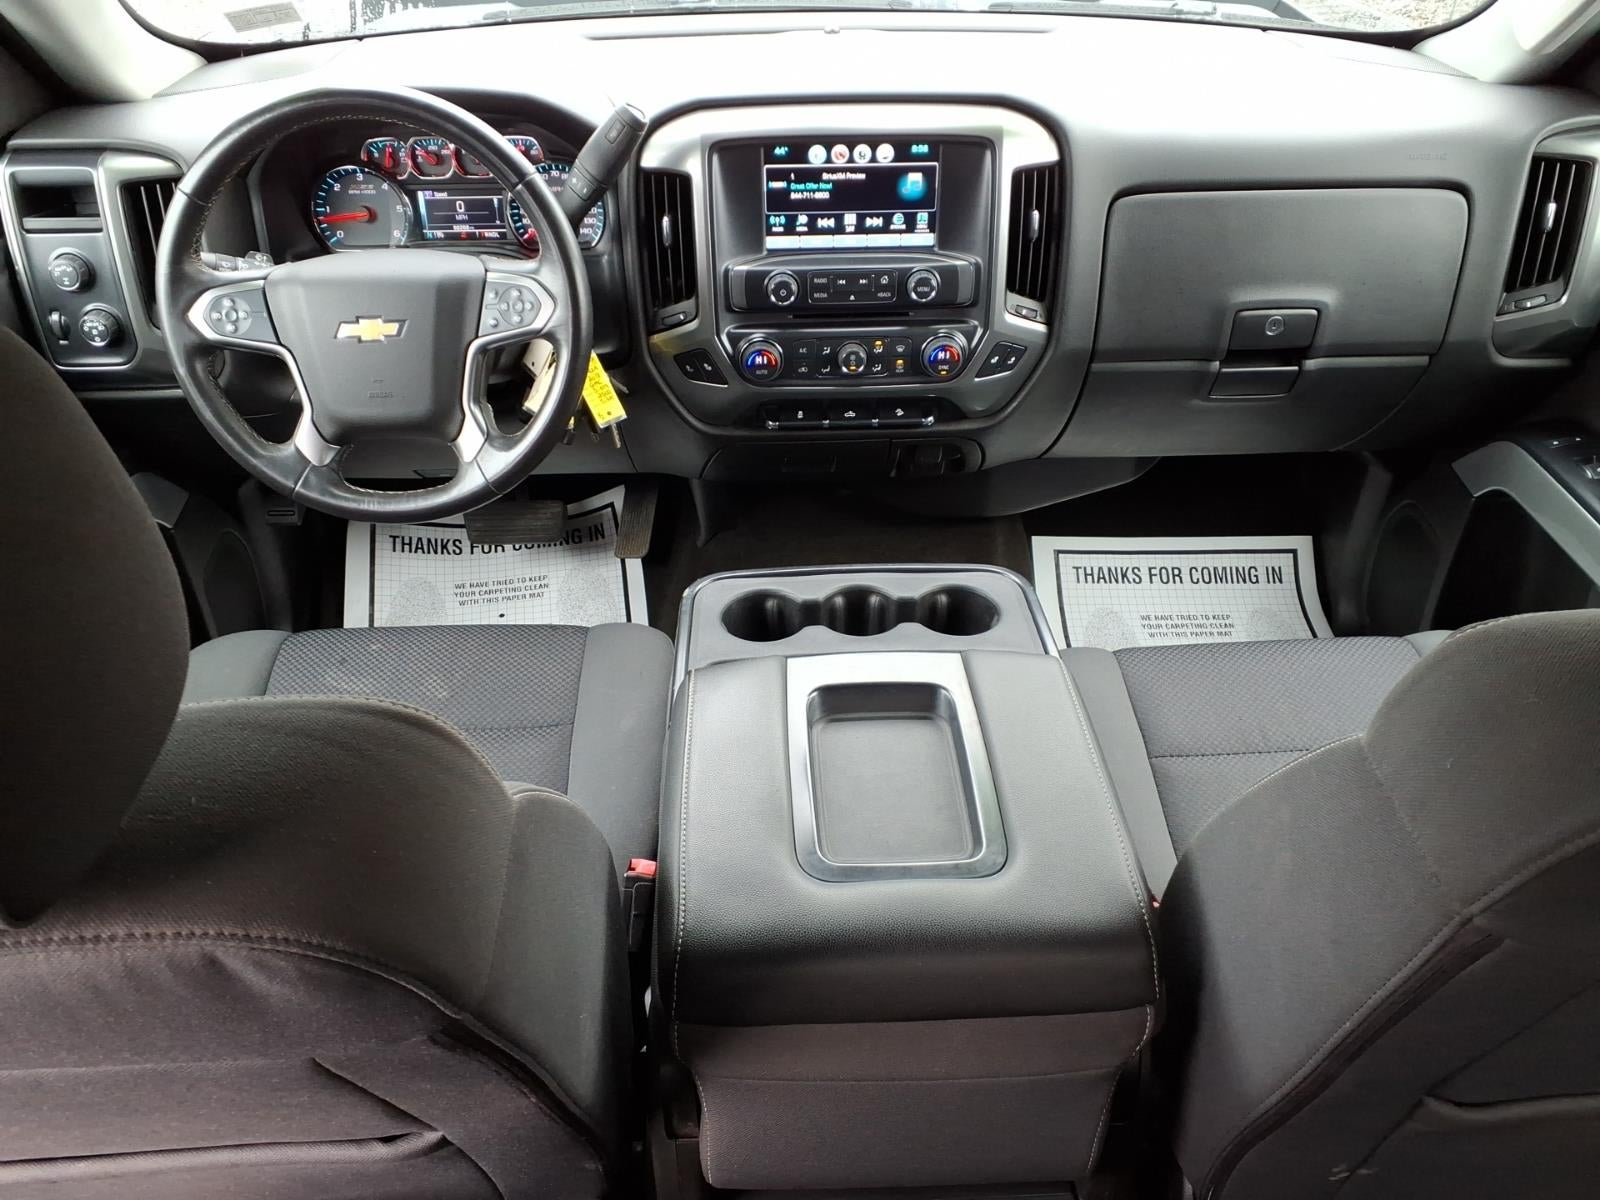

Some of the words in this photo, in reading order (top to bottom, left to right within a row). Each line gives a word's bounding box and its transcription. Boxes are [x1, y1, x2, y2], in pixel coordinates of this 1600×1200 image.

[356, 173, 363, 181] 3
[846, 172, 866, 180] Preview
[334, 183, 341, 191] 2
[381, 183, 389, 191] 4
[325, 205, 330, 213] 1
[396, 205, 403, 213] 5
[456, 200, 465, 213] 0
[336, 230, 344, 238] 0
[393, 229, 400, 237] 6
[389, 535, 463, 556] THANKS
[588, 522, 606, 542] IN
[1072, 566, 1143, 585] THANKS
[1148, 566, 1184, 585] FOR
[1189, 566, 1260, 585] COMING
[1266, 566, 1284, 584] IN
[454, 582, 467, 590] WE
[469, 580, 489, 589] HAVE
[492, 578, 514, 587] TRIED
[516, 576, 527, 584] TO
[528, 574, 548, 582] KEEP
[454, 590, 476, 598] YOUR
[478, 586, 522, 597] CARPETING
[524, 582, 549, 591] CLEAN
[458, 599, 479, 607] WITH
[502, 593, 527, 601] PAPER
[529, 591, 545, 599] MAT
